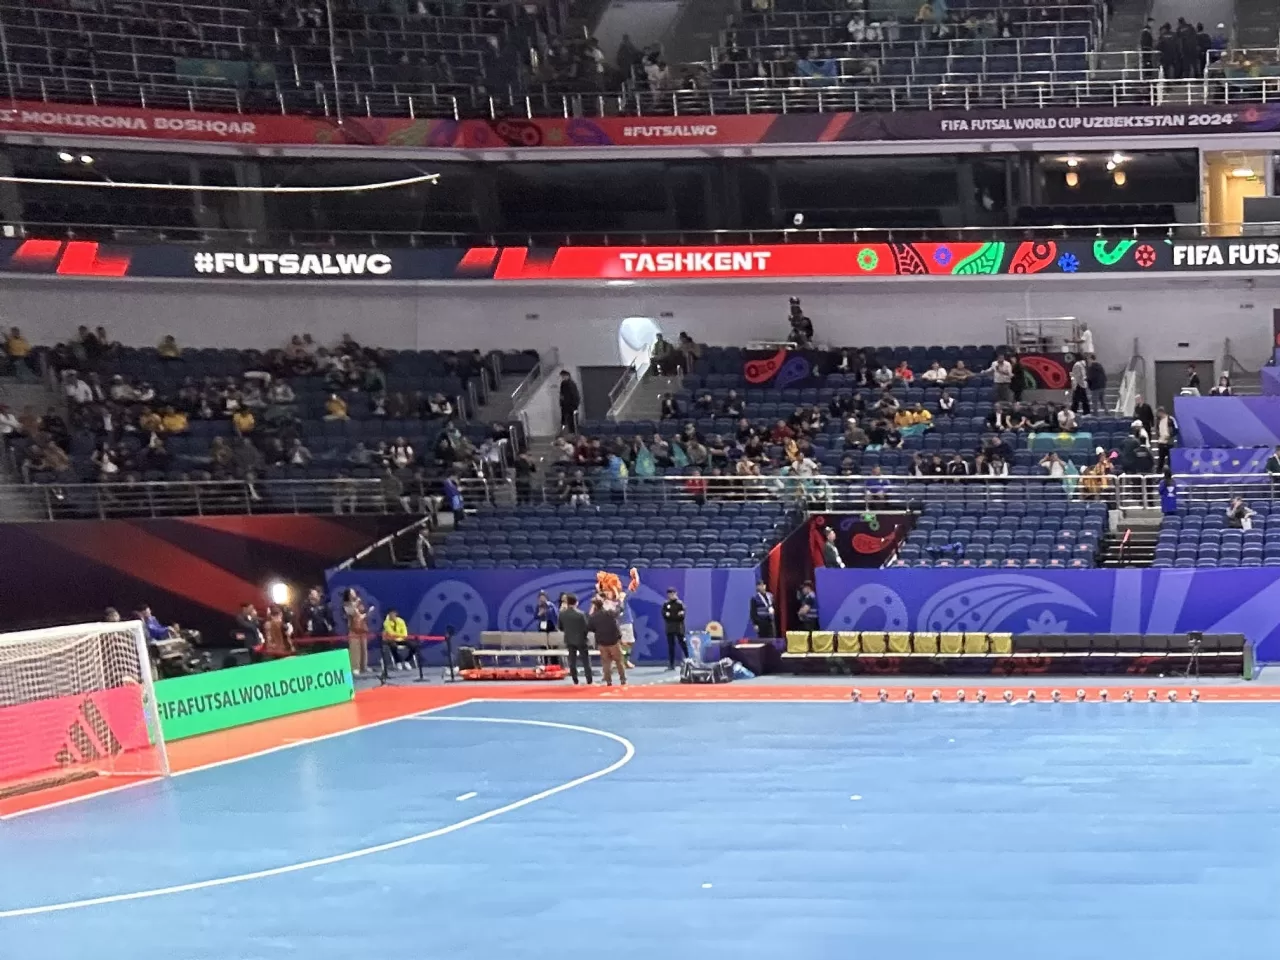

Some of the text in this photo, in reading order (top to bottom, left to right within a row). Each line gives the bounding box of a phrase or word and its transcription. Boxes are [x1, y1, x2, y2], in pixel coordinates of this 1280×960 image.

[21, 110, 147, 130] MOHIRONA
[153, 117, 256, 136] BOSHQAR
[623, 125, 717, 137] #FUTSALWC
[941, 120, 969, 131] FIFA
[971, 119, 1013, 131] FUTSAL
[1013, 118, 1056, 129] WORLD
[1058, 117, 1082, 128] CUP
[1083, 115, 1185, 128] UZBEKISTAN
[194, 252, 392, 275] #FUTSALWC
[619, 251, 771, 272] TASHKENT
[1173, 244, 1224, 265] FIFA
